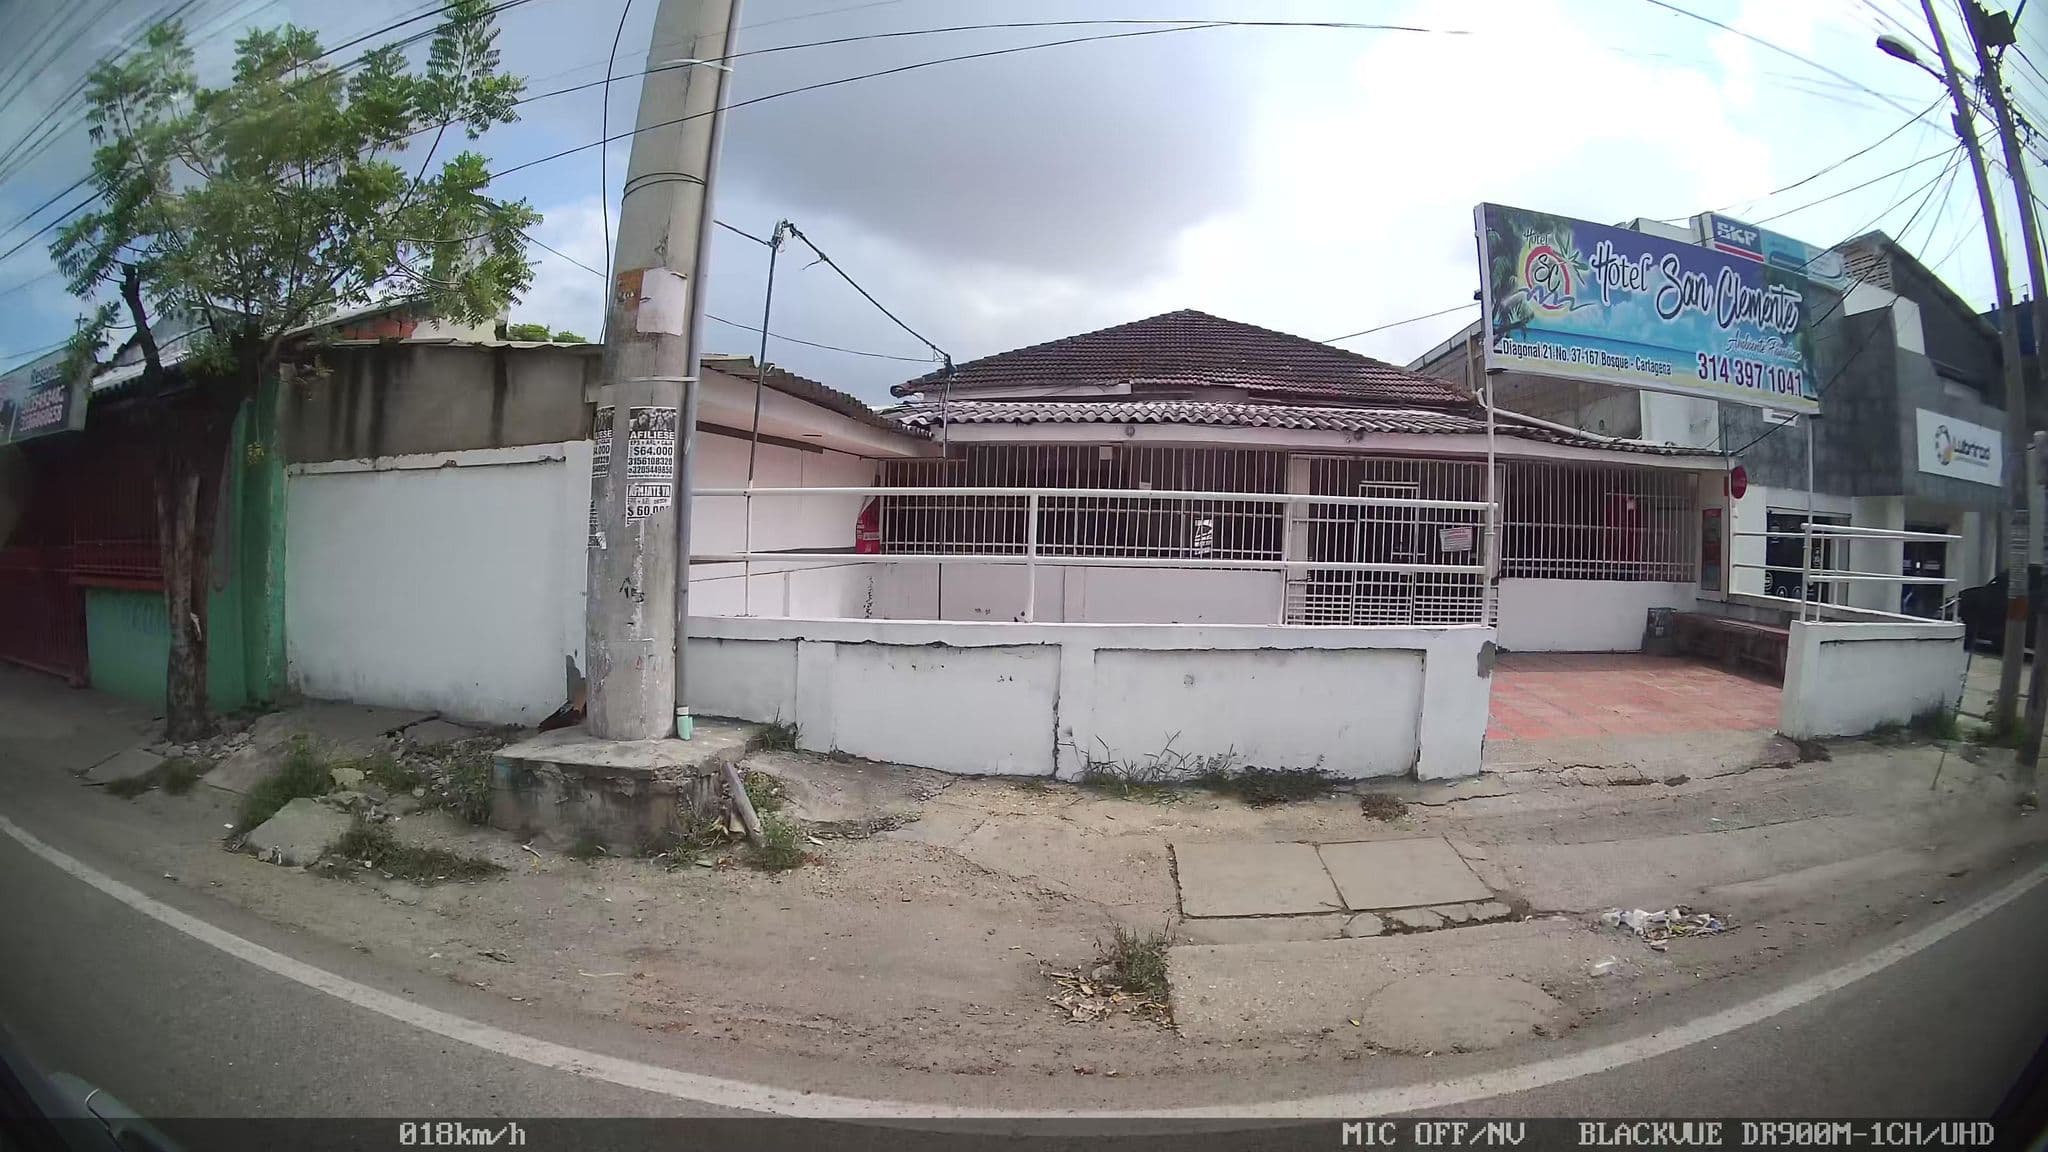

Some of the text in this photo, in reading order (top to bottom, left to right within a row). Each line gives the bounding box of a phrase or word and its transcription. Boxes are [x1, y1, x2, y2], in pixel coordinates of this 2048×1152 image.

[1523, 227, 1553, 249] Hotel
[1716, 221, 1758, 247] SKF
[1591, 241, 1804, 334] Hotel San Clemente
[1501, 338, 1542, 361] Diagonal
[1571, 348, 1600, 367] 37-167
[1601, 350, 1631, 373] Bosque
[1635, 355, 1673, 377] Cartagena
[1697, 352, 1803, 398] 314 397 1041
[630, 430, 675, 440] AFILIESE
[633, 446, 673, 456] $64.000
